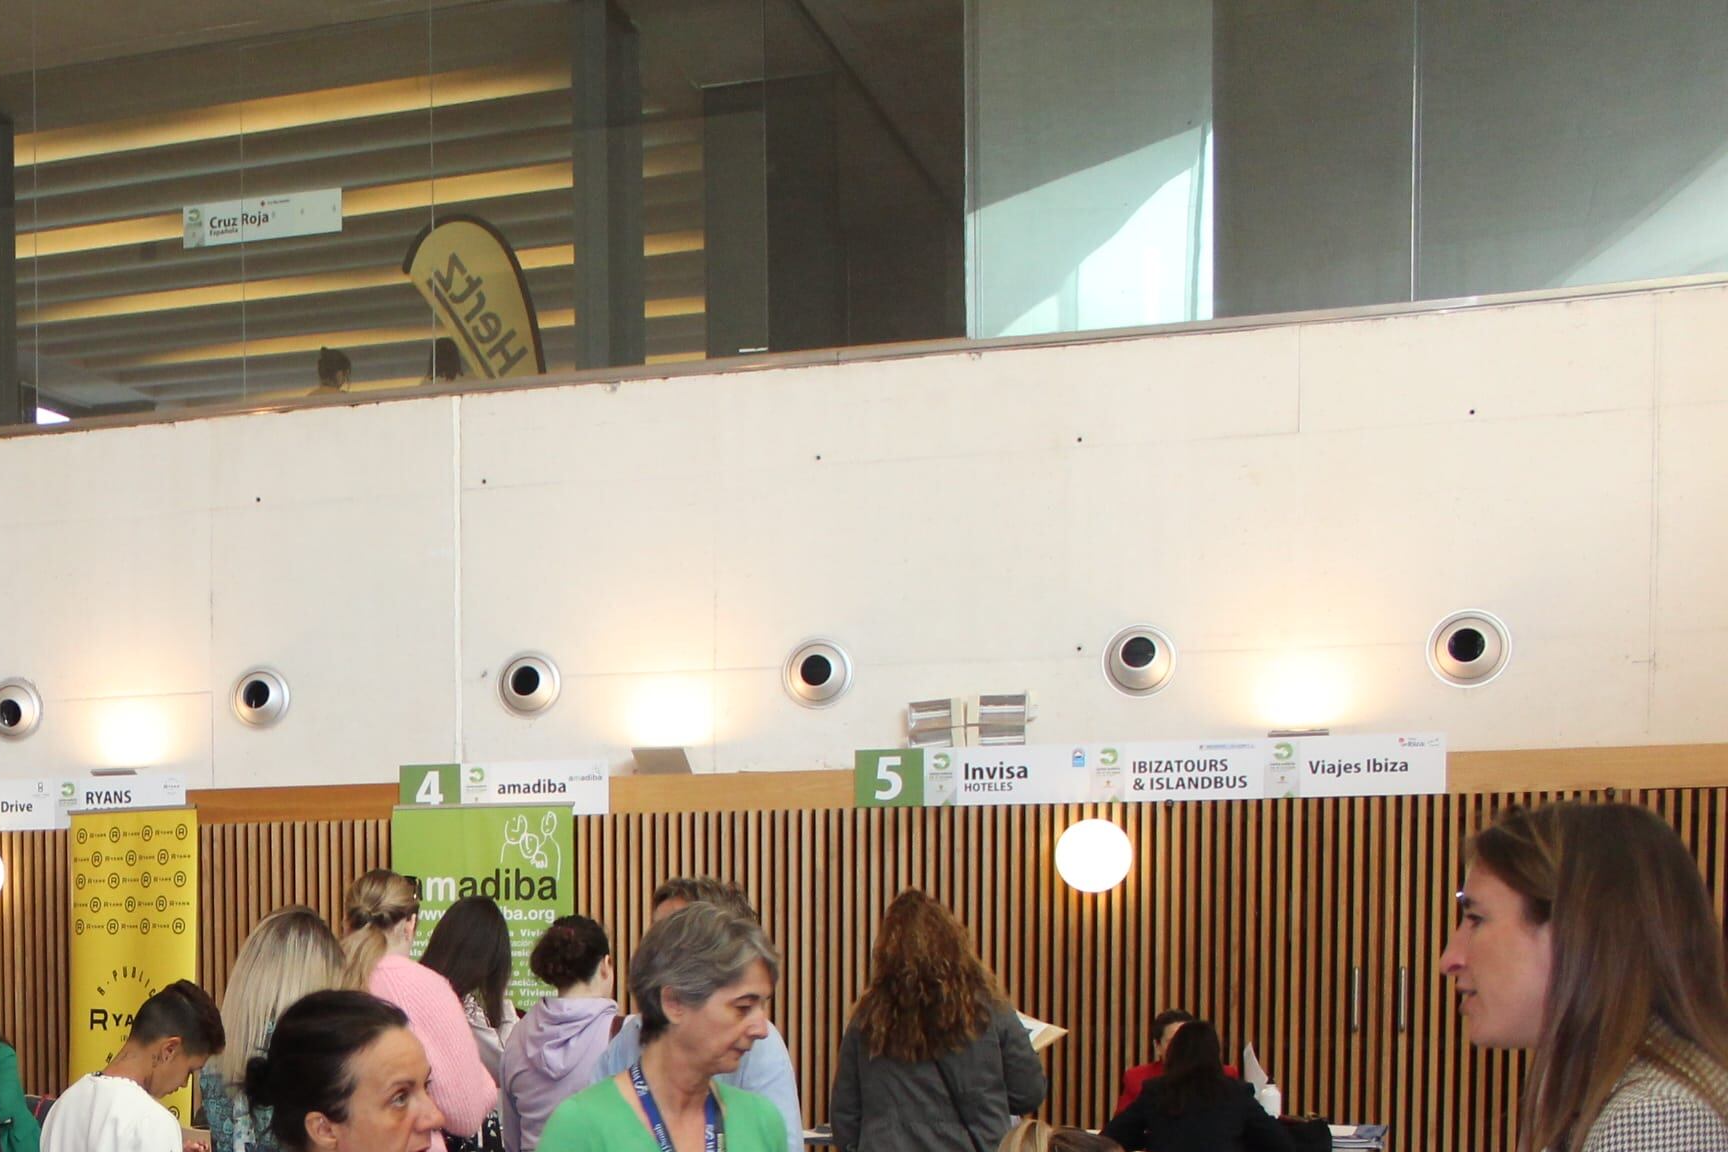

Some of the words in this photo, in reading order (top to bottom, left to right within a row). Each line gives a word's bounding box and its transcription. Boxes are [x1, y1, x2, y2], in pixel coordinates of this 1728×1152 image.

[210, 216, 238, 229] Cruz
[242, 211, 269, 227] Roja
[964, 761, 1028, 780] Invisa
[1132, 758, 1229, 774] IBIZATOURS
[1308, 759, 1362, 777] Viajes
[1366, 757, 1409, 773] Ibiza
[874, 755, 903, 801] 5
[1132, 777, 1145, 791] &
[1150, 775, 1248, 791] ISLANDBUS
[415, 770, 444, 805] 4
[497, 779, 567, 795] amadiba
[964, 781, 1013, 793] HOTELES
[85, 790, 132, 805] RYANS
[0, 800, 33, 813] Drive
[417, 867, 558, 901] madiba
